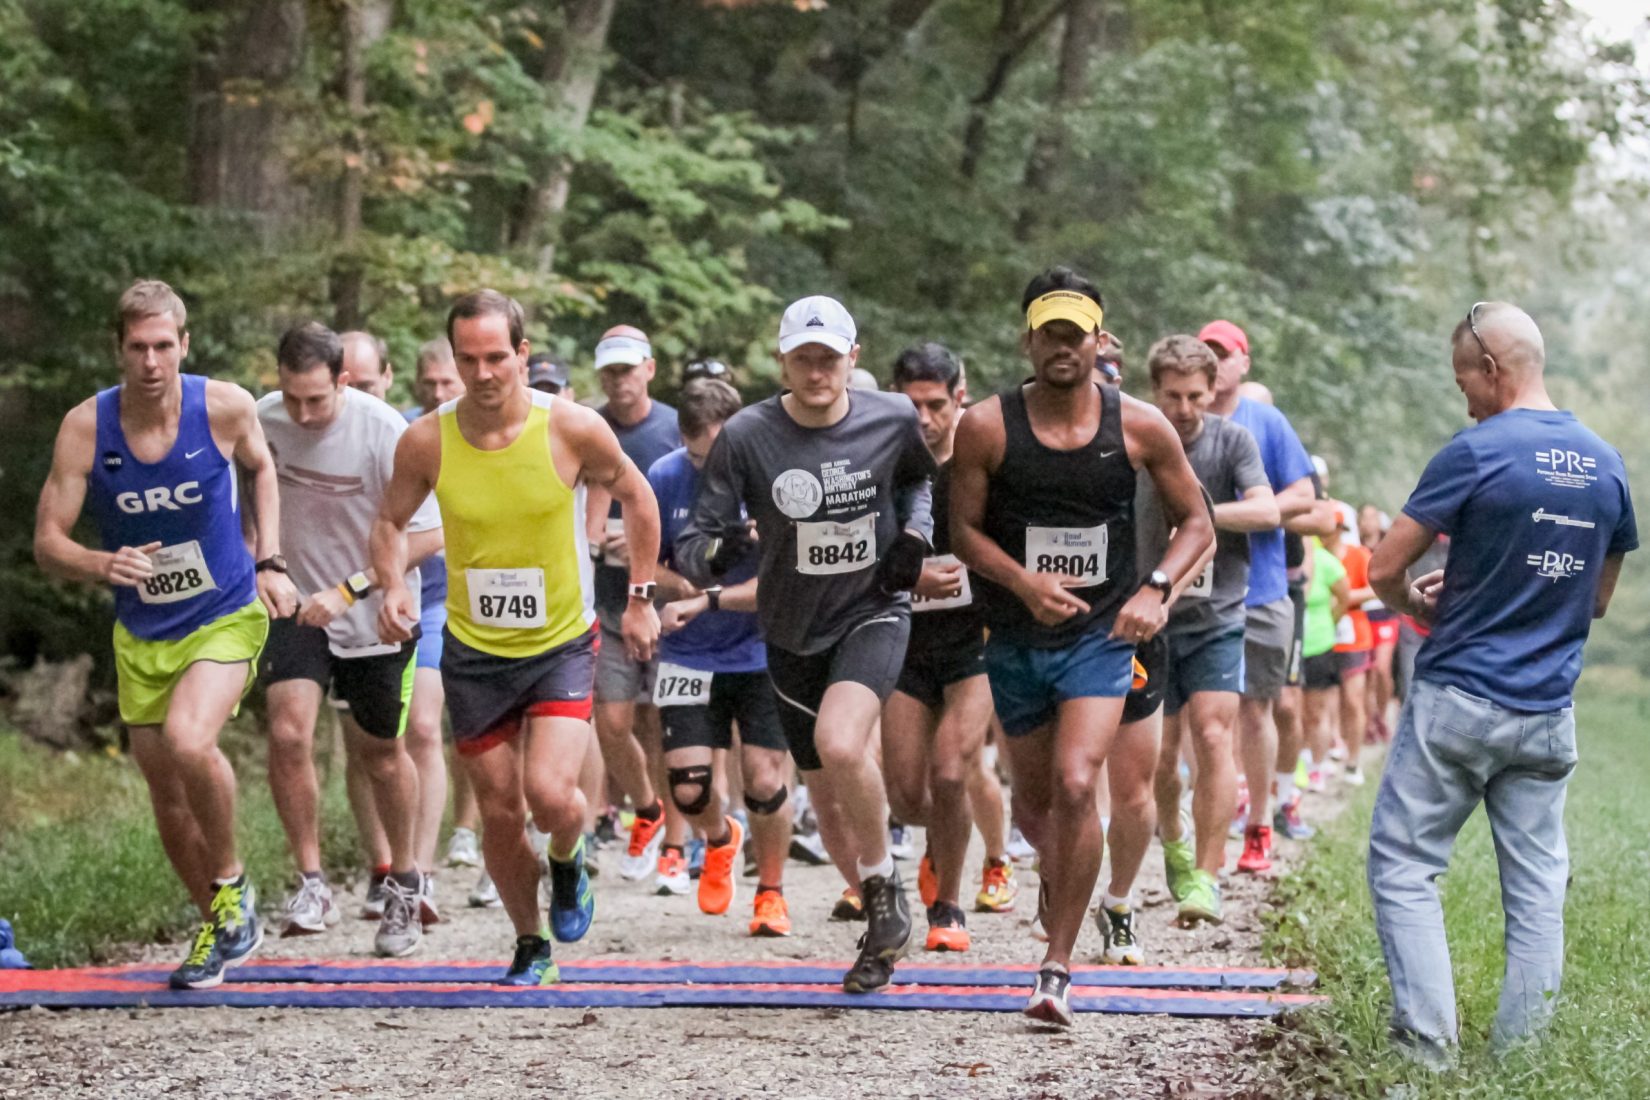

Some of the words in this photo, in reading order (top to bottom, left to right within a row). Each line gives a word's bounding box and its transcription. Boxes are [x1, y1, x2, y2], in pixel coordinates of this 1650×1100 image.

[116, 480, 203, 514] GRC
[825, 485, 877, 506] MARATHON
[1064, 531, 1081, 540] Road
[808, 539, 869, 566] 8842
[1036, 552, 1099, 577] 8804
[143, 567, 203, 596] 8828
[479, 594, 537, 619] 8749
[658, 676, 703, 699] 8728
